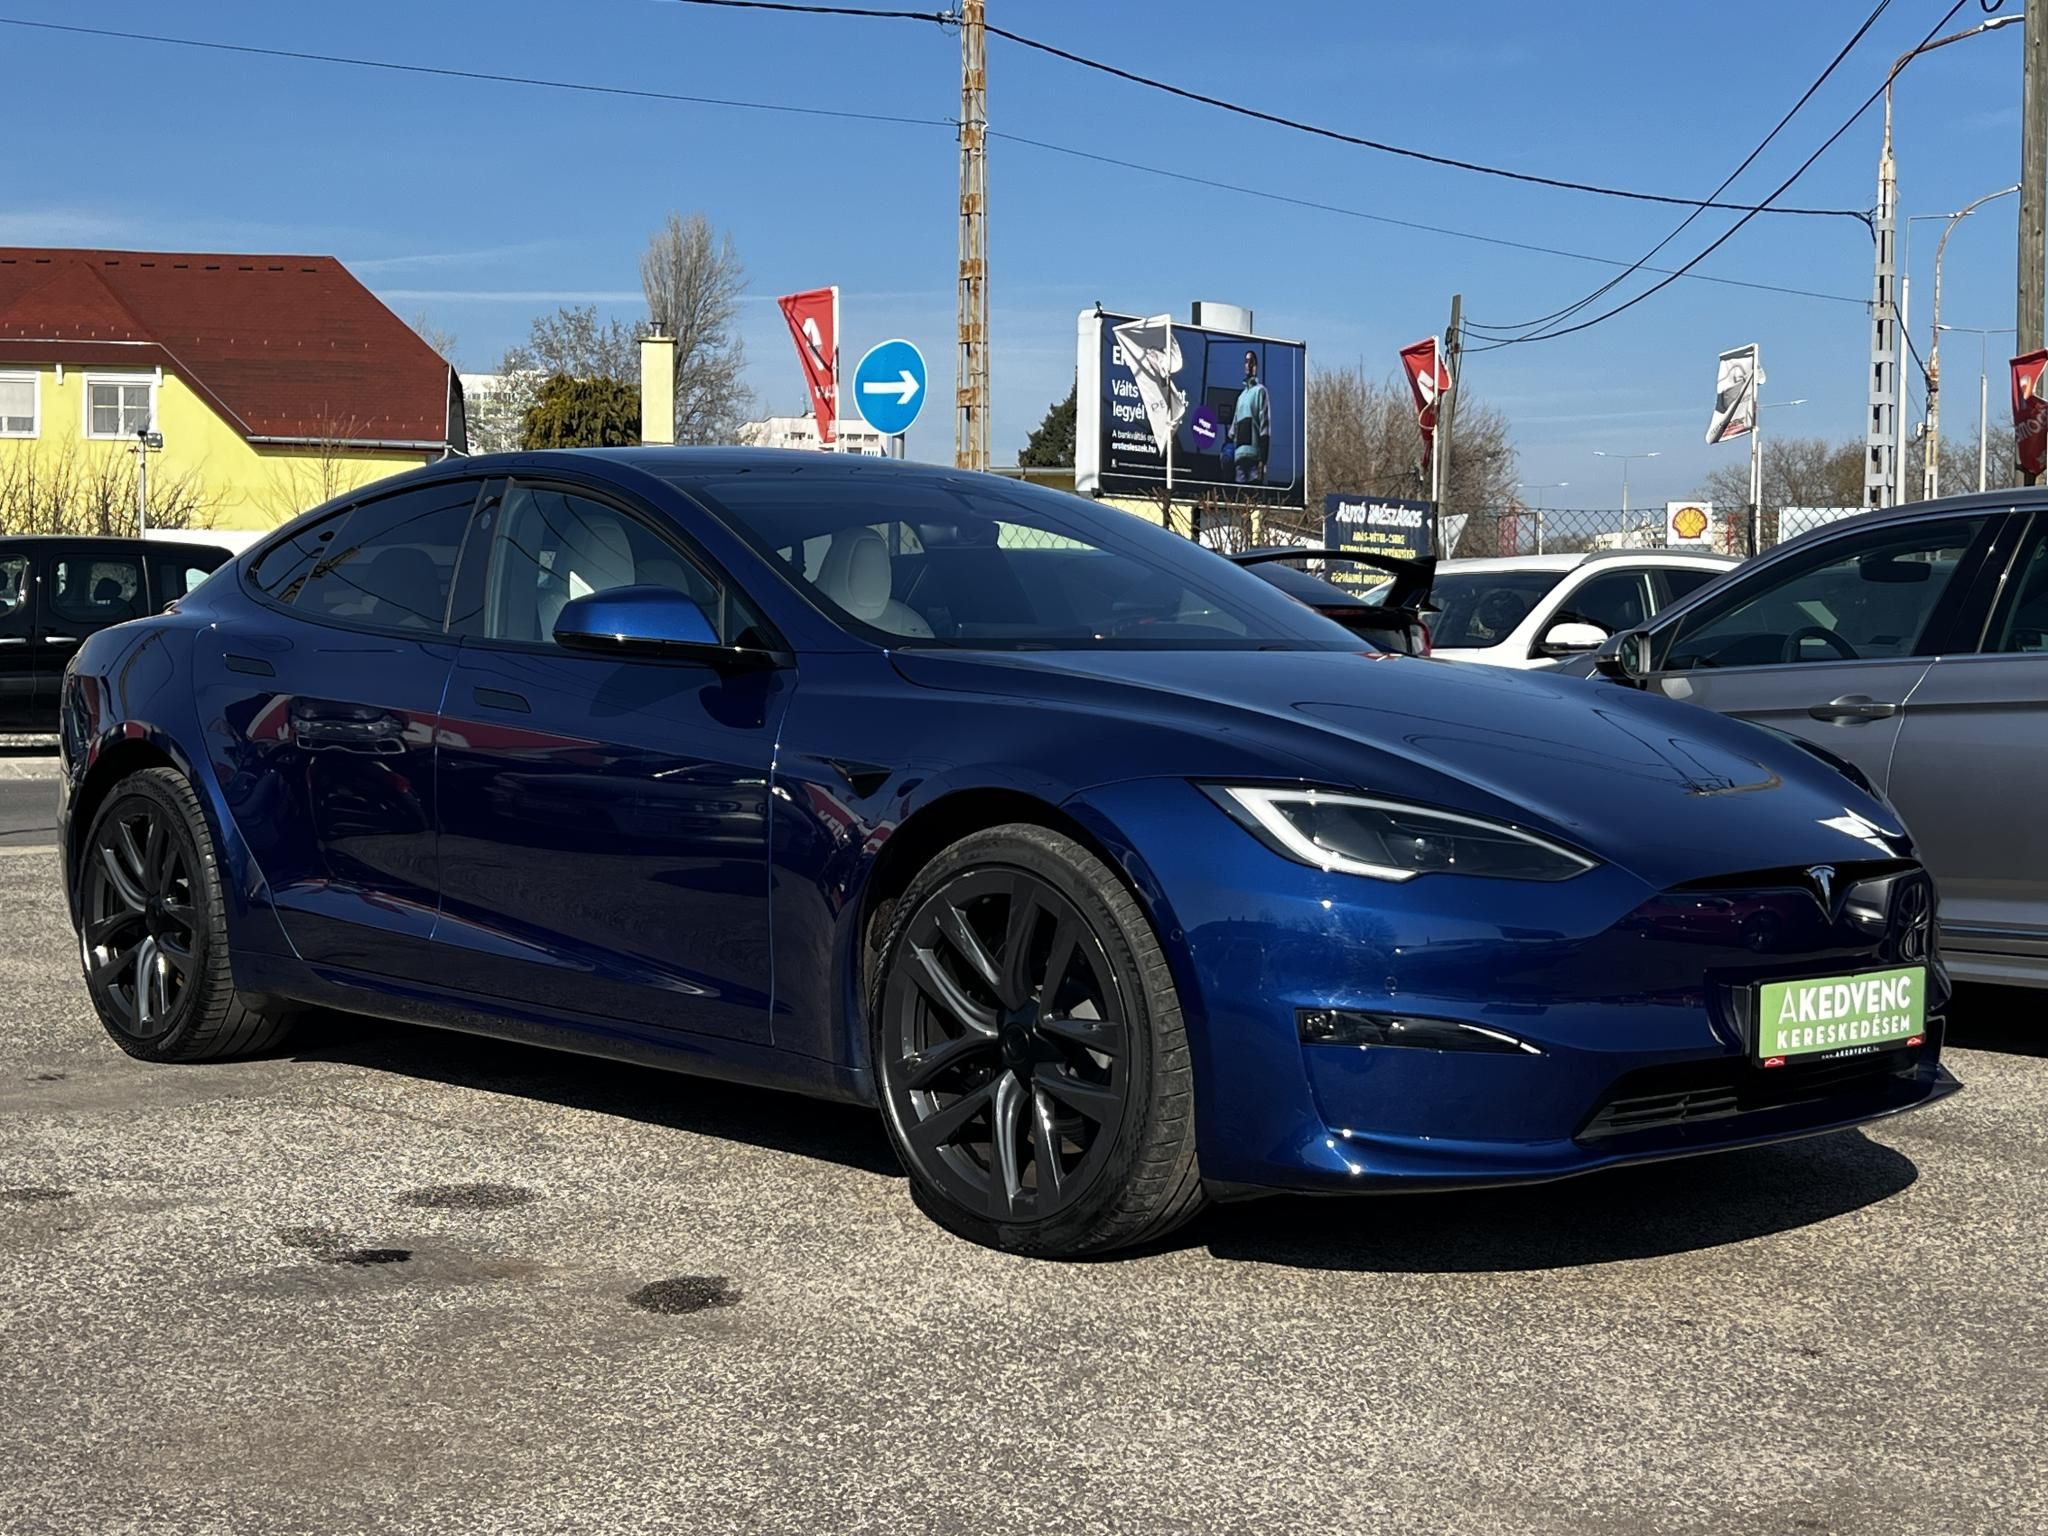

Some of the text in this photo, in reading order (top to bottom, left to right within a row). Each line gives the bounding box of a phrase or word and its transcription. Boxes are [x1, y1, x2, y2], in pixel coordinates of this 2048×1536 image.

[1112, 379, 1139, 398] Válts
[1112, 401, 1145, 422] legyél
[1112, 429, 1117, 438] A
[1335, 501, 1367, 523] AUTÓ
[1778, 976, 1912, 1025] AKEDVENC
[1777, 1014, 1911, 1050] KERESKEDÉSEM
